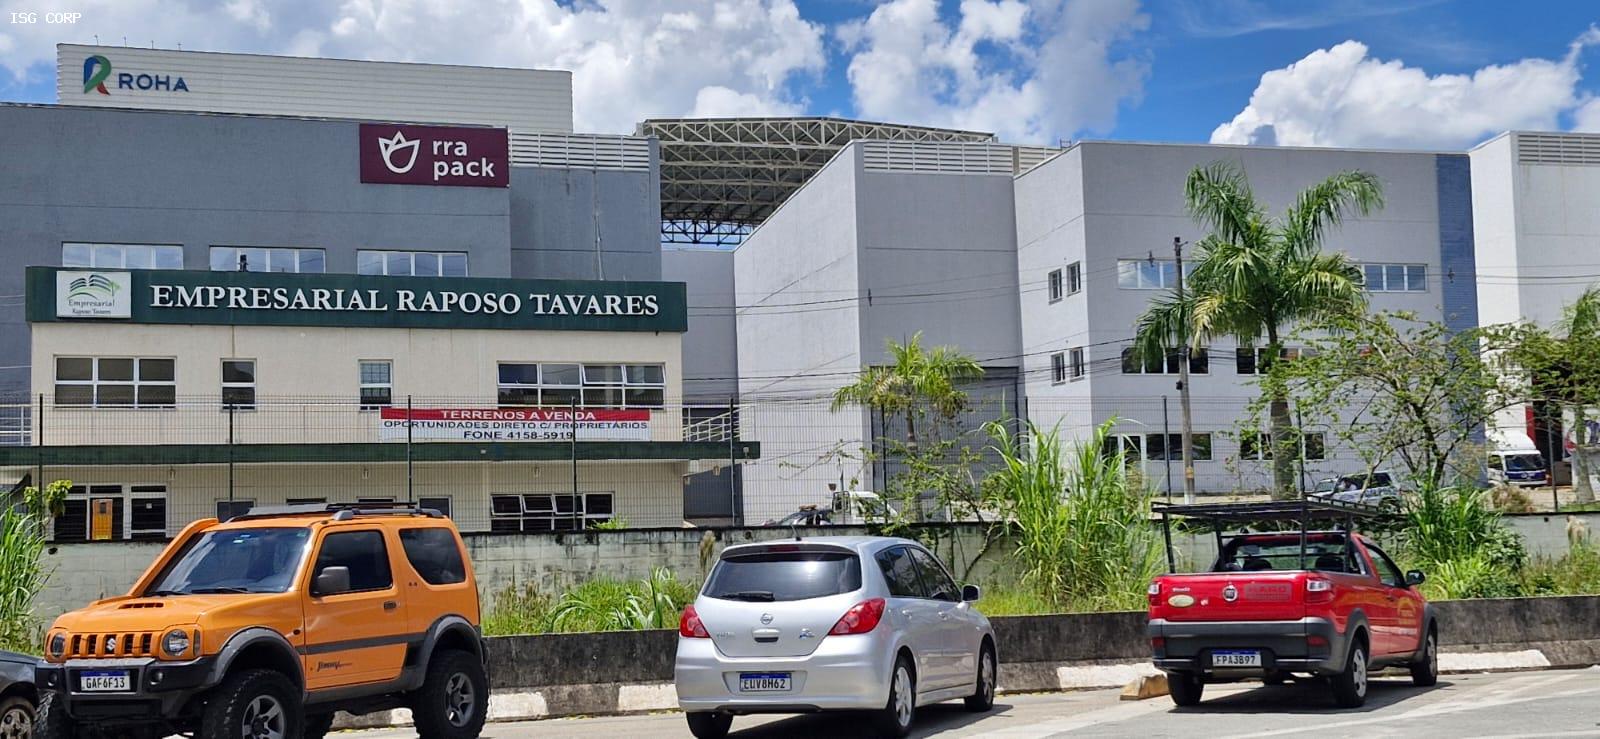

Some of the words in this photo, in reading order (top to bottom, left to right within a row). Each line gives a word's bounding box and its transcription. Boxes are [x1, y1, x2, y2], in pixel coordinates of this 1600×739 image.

[118, 72, 189, 92] ROHA
[432, 140, 468, 157] rra
[433, 157, 495, 181] pack
[68, 299, 115, 308] Empresarial
[149, 284, 388, 312] EMPRESARIAL
[396, 289, 522, 315] RAPOSO
[529, 293, 660, 316] TAVARES
[441, 410, 525, 420] TERRENOS
[528, 411, 540, 420] A
[543, 411, 596, 420] VENDA
[384, 420, 489, 429] OPORTUNIDADES
[493, 421, 536, 430] DIRETO
[540, 422, 552, 430] C/
[463, 430, 502, 440] FONE
[506, 431, 573, 440] 4158-5919
[1216, 655, 1256, 665] FPA3B97
[86, 677, 125, 689] GAF6F13
[743, 678, 786, 690] EUV8H62
